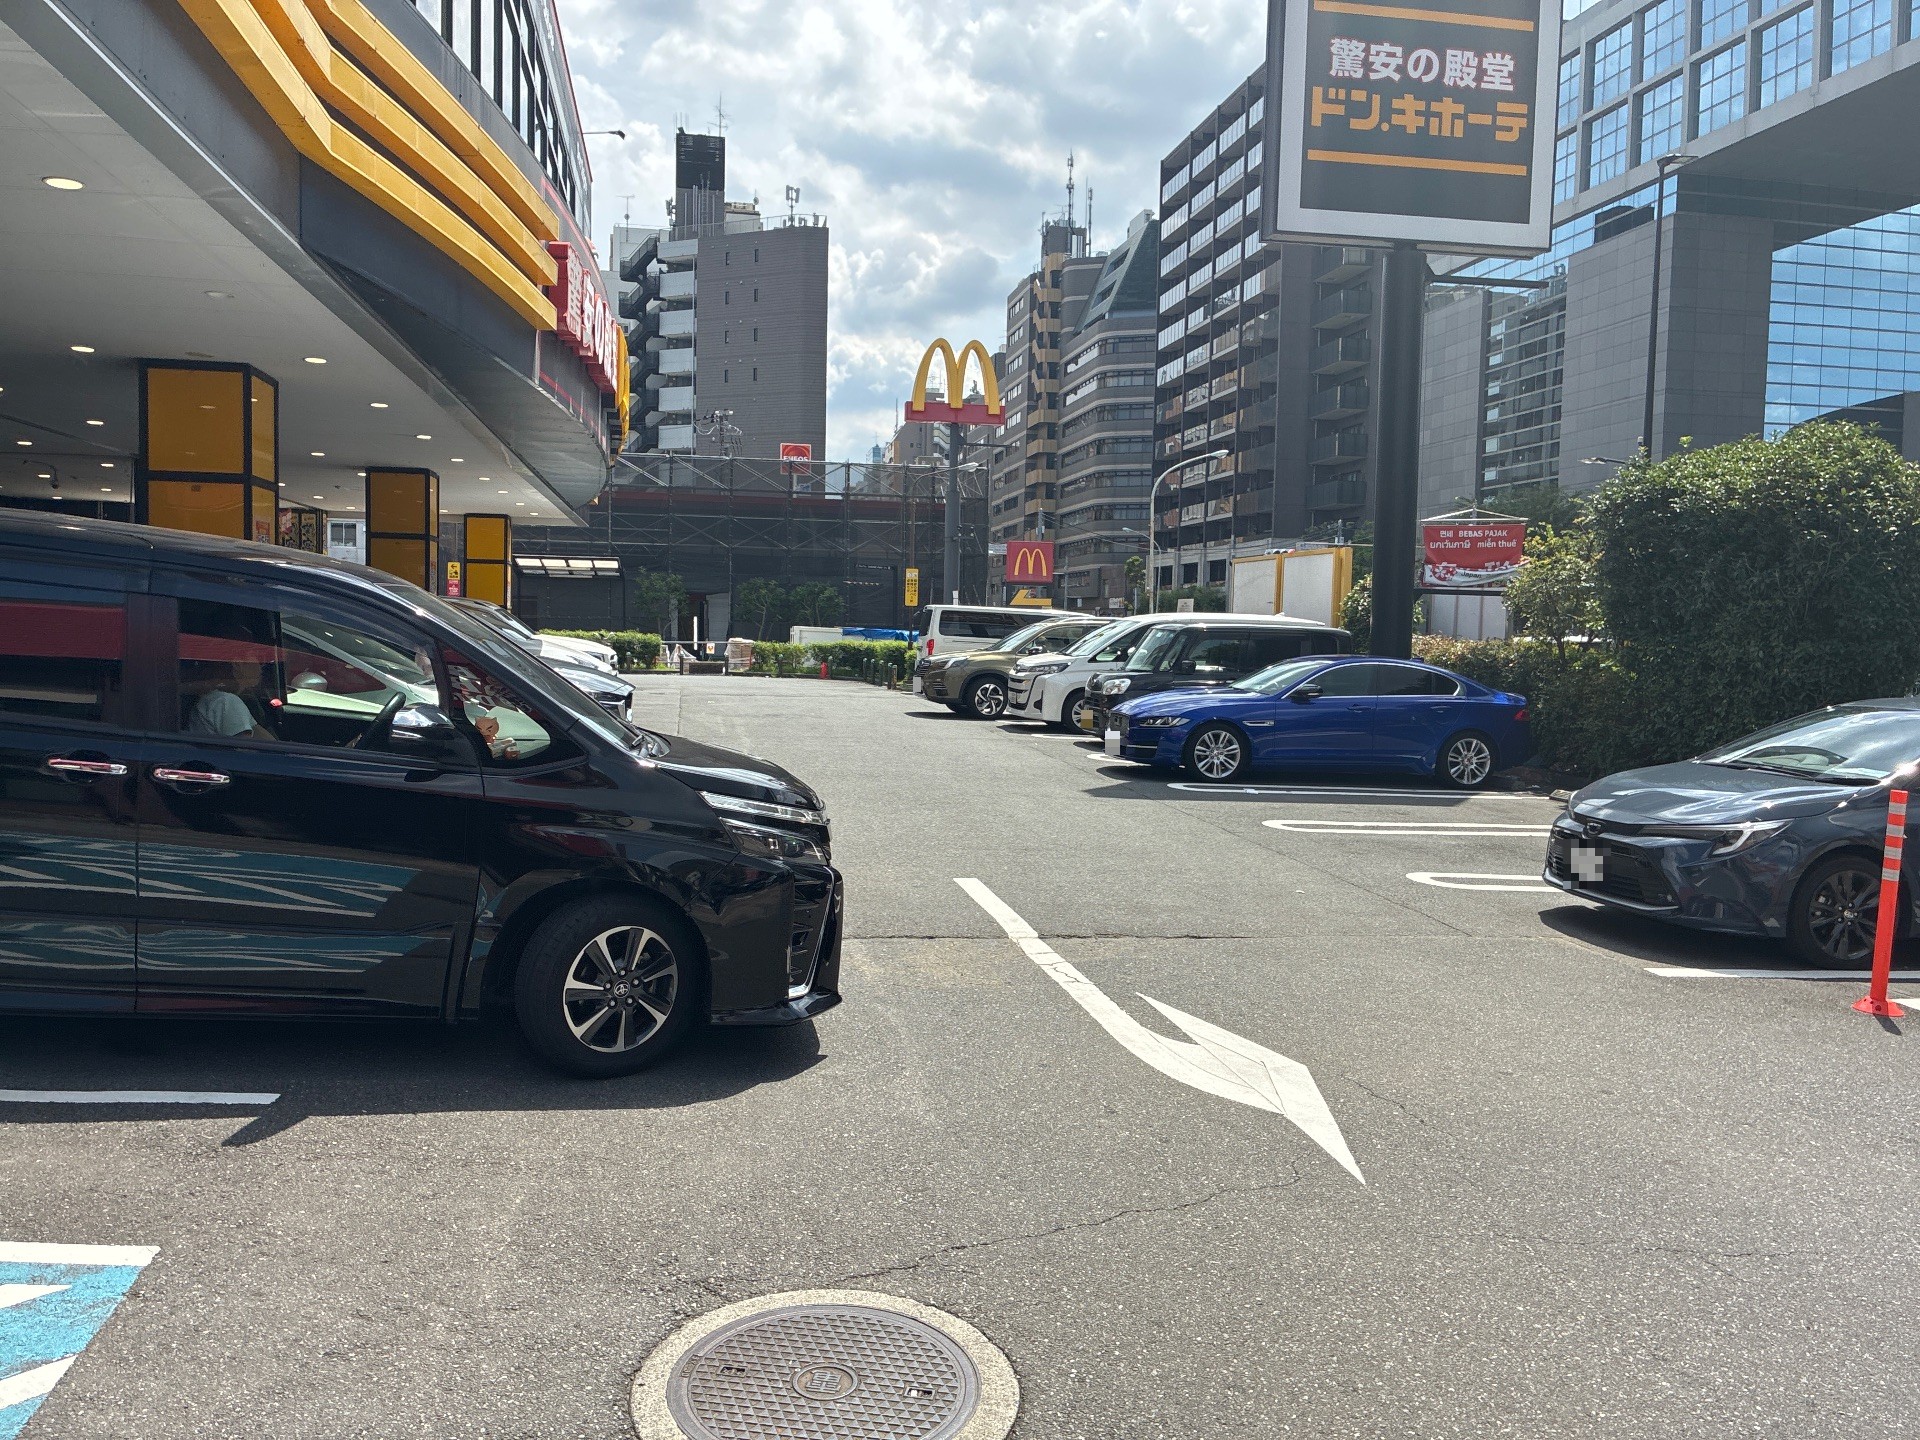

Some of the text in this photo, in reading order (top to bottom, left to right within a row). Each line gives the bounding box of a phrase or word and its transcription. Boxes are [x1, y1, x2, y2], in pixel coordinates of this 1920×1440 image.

[1329, 37, 1514, 91] 驚安の殿堂
[1458, 529, 1508, 538] BEBAS PAJAK
